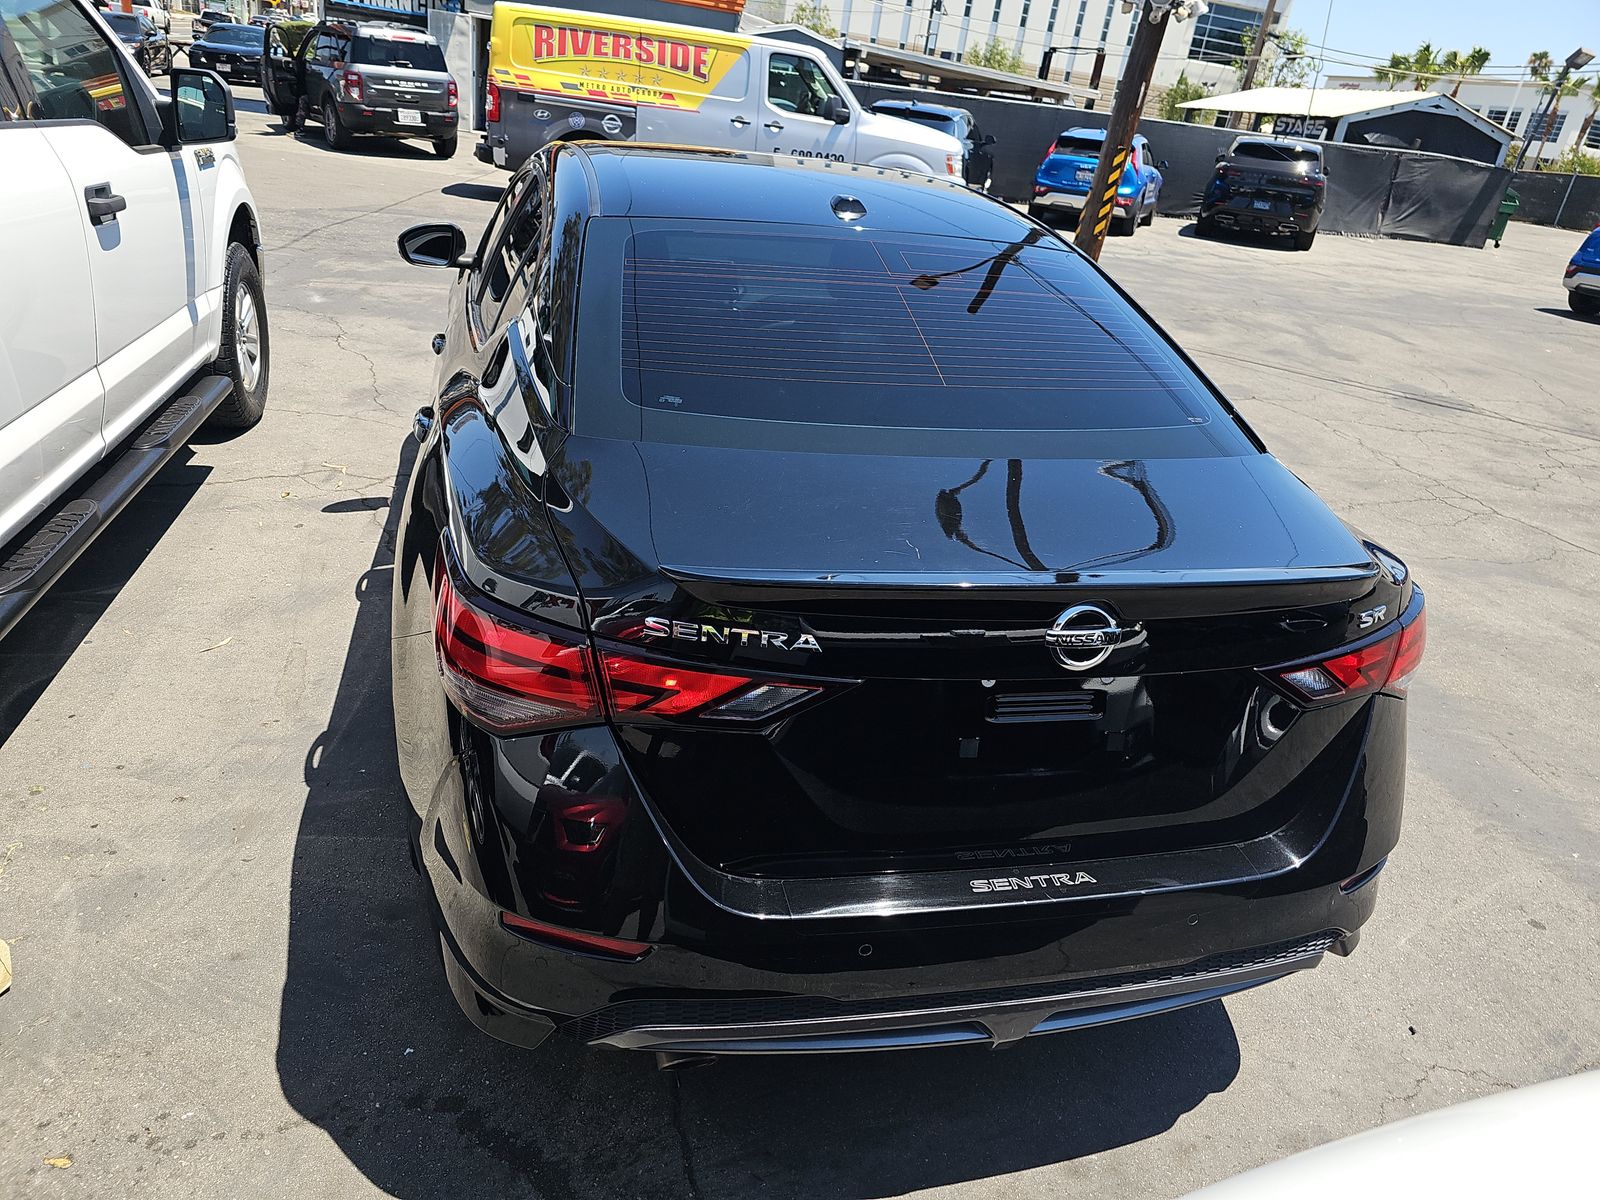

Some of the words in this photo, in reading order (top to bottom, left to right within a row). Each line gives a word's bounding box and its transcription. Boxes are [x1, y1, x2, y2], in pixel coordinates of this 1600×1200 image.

[533, 24, 710, 81] RIVERSIDE
[579, 82, 607, 91] METRO
[611, 85, 632, 94] AUTO
[636, 88, 663, 97] GROUP
[1274, 116, 1326, 135] STAGE
[1359, 605, 1387, 629] SR
[643, 616, 823, 653] SENTRA
[1055, 631, 1119, 646] NISSAN
[969, 871, 1098, 893] SENTRA
